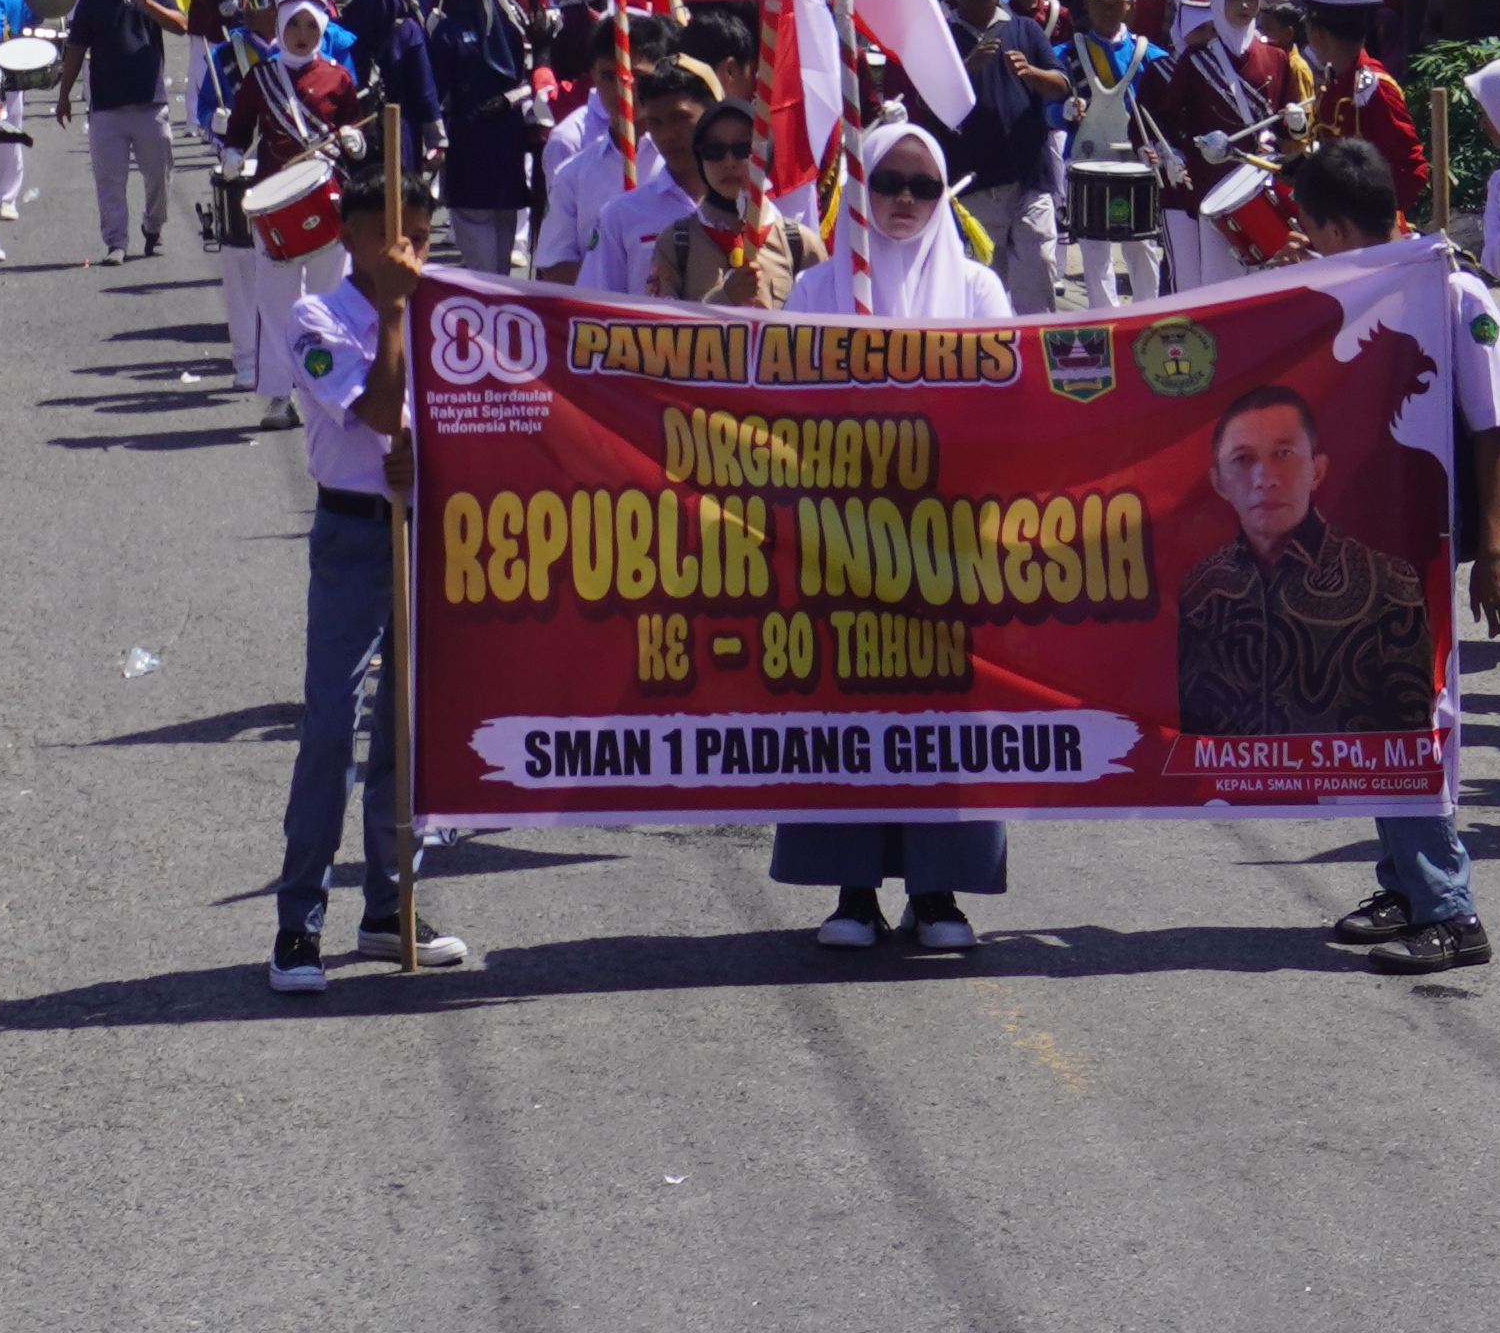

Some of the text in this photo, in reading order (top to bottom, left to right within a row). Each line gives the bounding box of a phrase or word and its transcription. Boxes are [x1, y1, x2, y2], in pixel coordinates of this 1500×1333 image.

[430, 295, 548, 385] 80
[571, 320, 1018, 386] PAWAI ALEGORIS
[426, 388, 553, 404] Bersatu Berdaulat
[430, 404, 550, 422] Rakyat Sejahtera
[437, 419, 542, 436] Indonesia Maju
[663, 406, 931, 490] DIRGAHAYU
[444, 488, 1150, 606] REPUBLIK INDONESIA
[637, 612, 690, 682] KE
[762, 610, 814, 680] 80
[830, 610, 966, 679] TAHUN
[524, 723, 1083, 778] SMAN 1 PADANG GELUGUR
[1194, 739, 1304, 769] MASRIL,
[1310, 739, 1377, 770] S.Pd.,
[1215, 779, 1264, 791] KEPALA
[1267, 778, 1303, 791] SMAN
[1314, 777, 1368, 791] PADANG
[1371, 777, 1429, 790] GELUGUR
